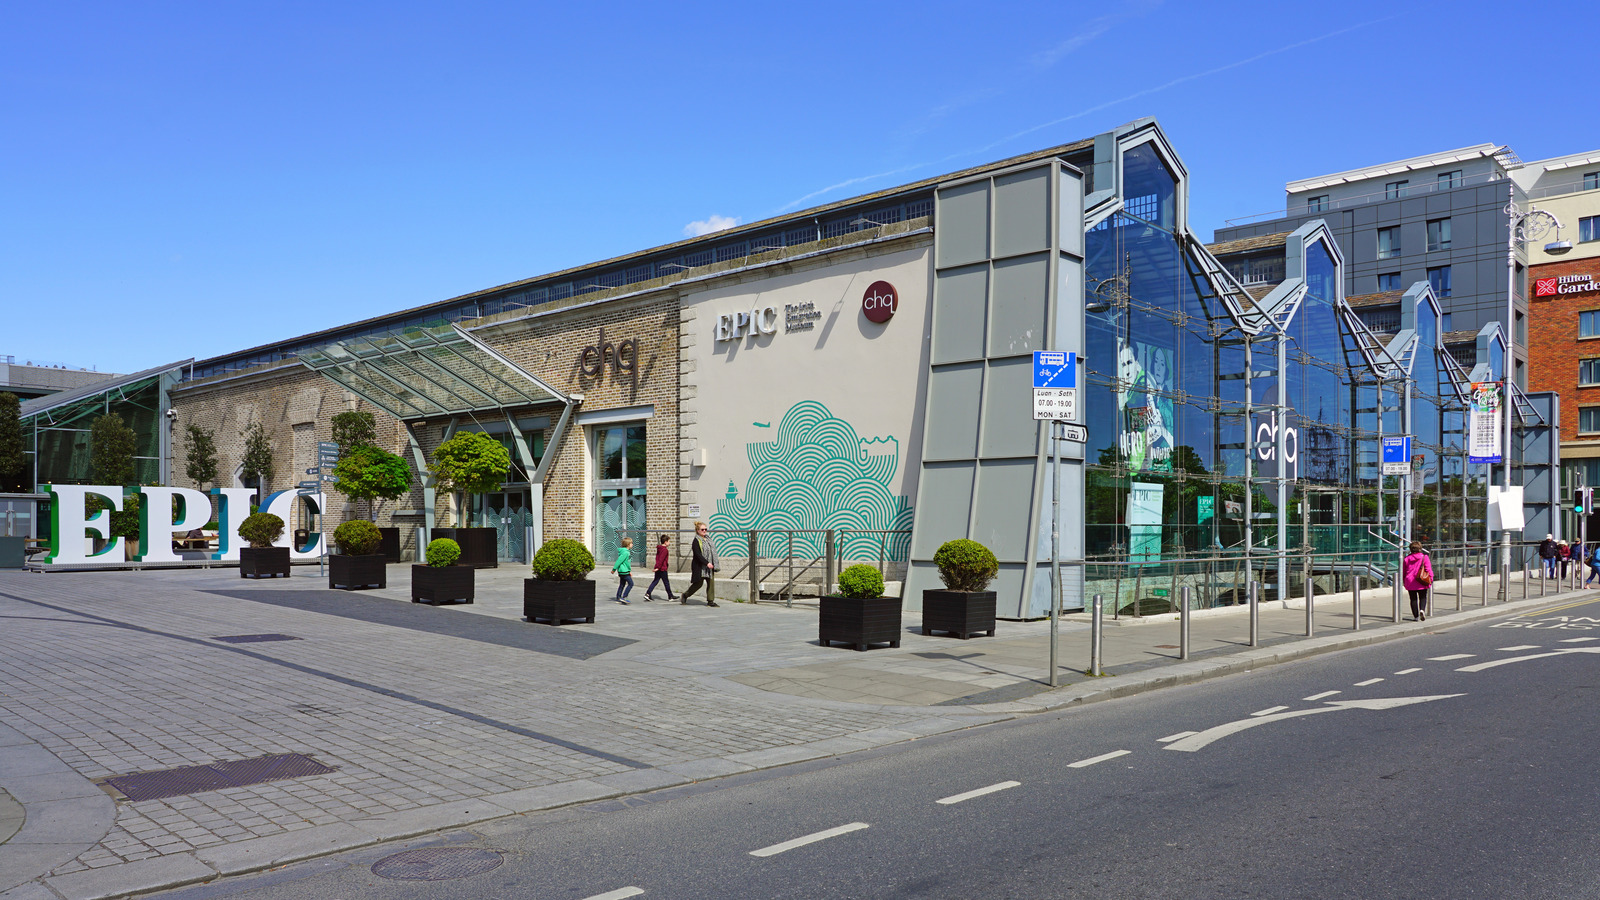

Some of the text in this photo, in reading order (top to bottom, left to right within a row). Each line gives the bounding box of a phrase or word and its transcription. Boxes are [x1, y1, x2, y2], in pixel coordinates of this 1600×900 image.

[1558, 275, 1592, 284] Hilton
[1558, 281, 1600, 294] Garde
[785, 303, 798, 313] The
[865, 290, 895, 314] chq
[716, 306, 777, 342] EPIC
[581, 327, 638, 391] chq
[1038, 399, 1053, 407] 07.00
[1120, 430, 1143, 457] HERO
[1257, 410, 1298, 484] chq
[44, 484, 327, 564] EPIC
[1489, 622, 1600, 630] BUS
